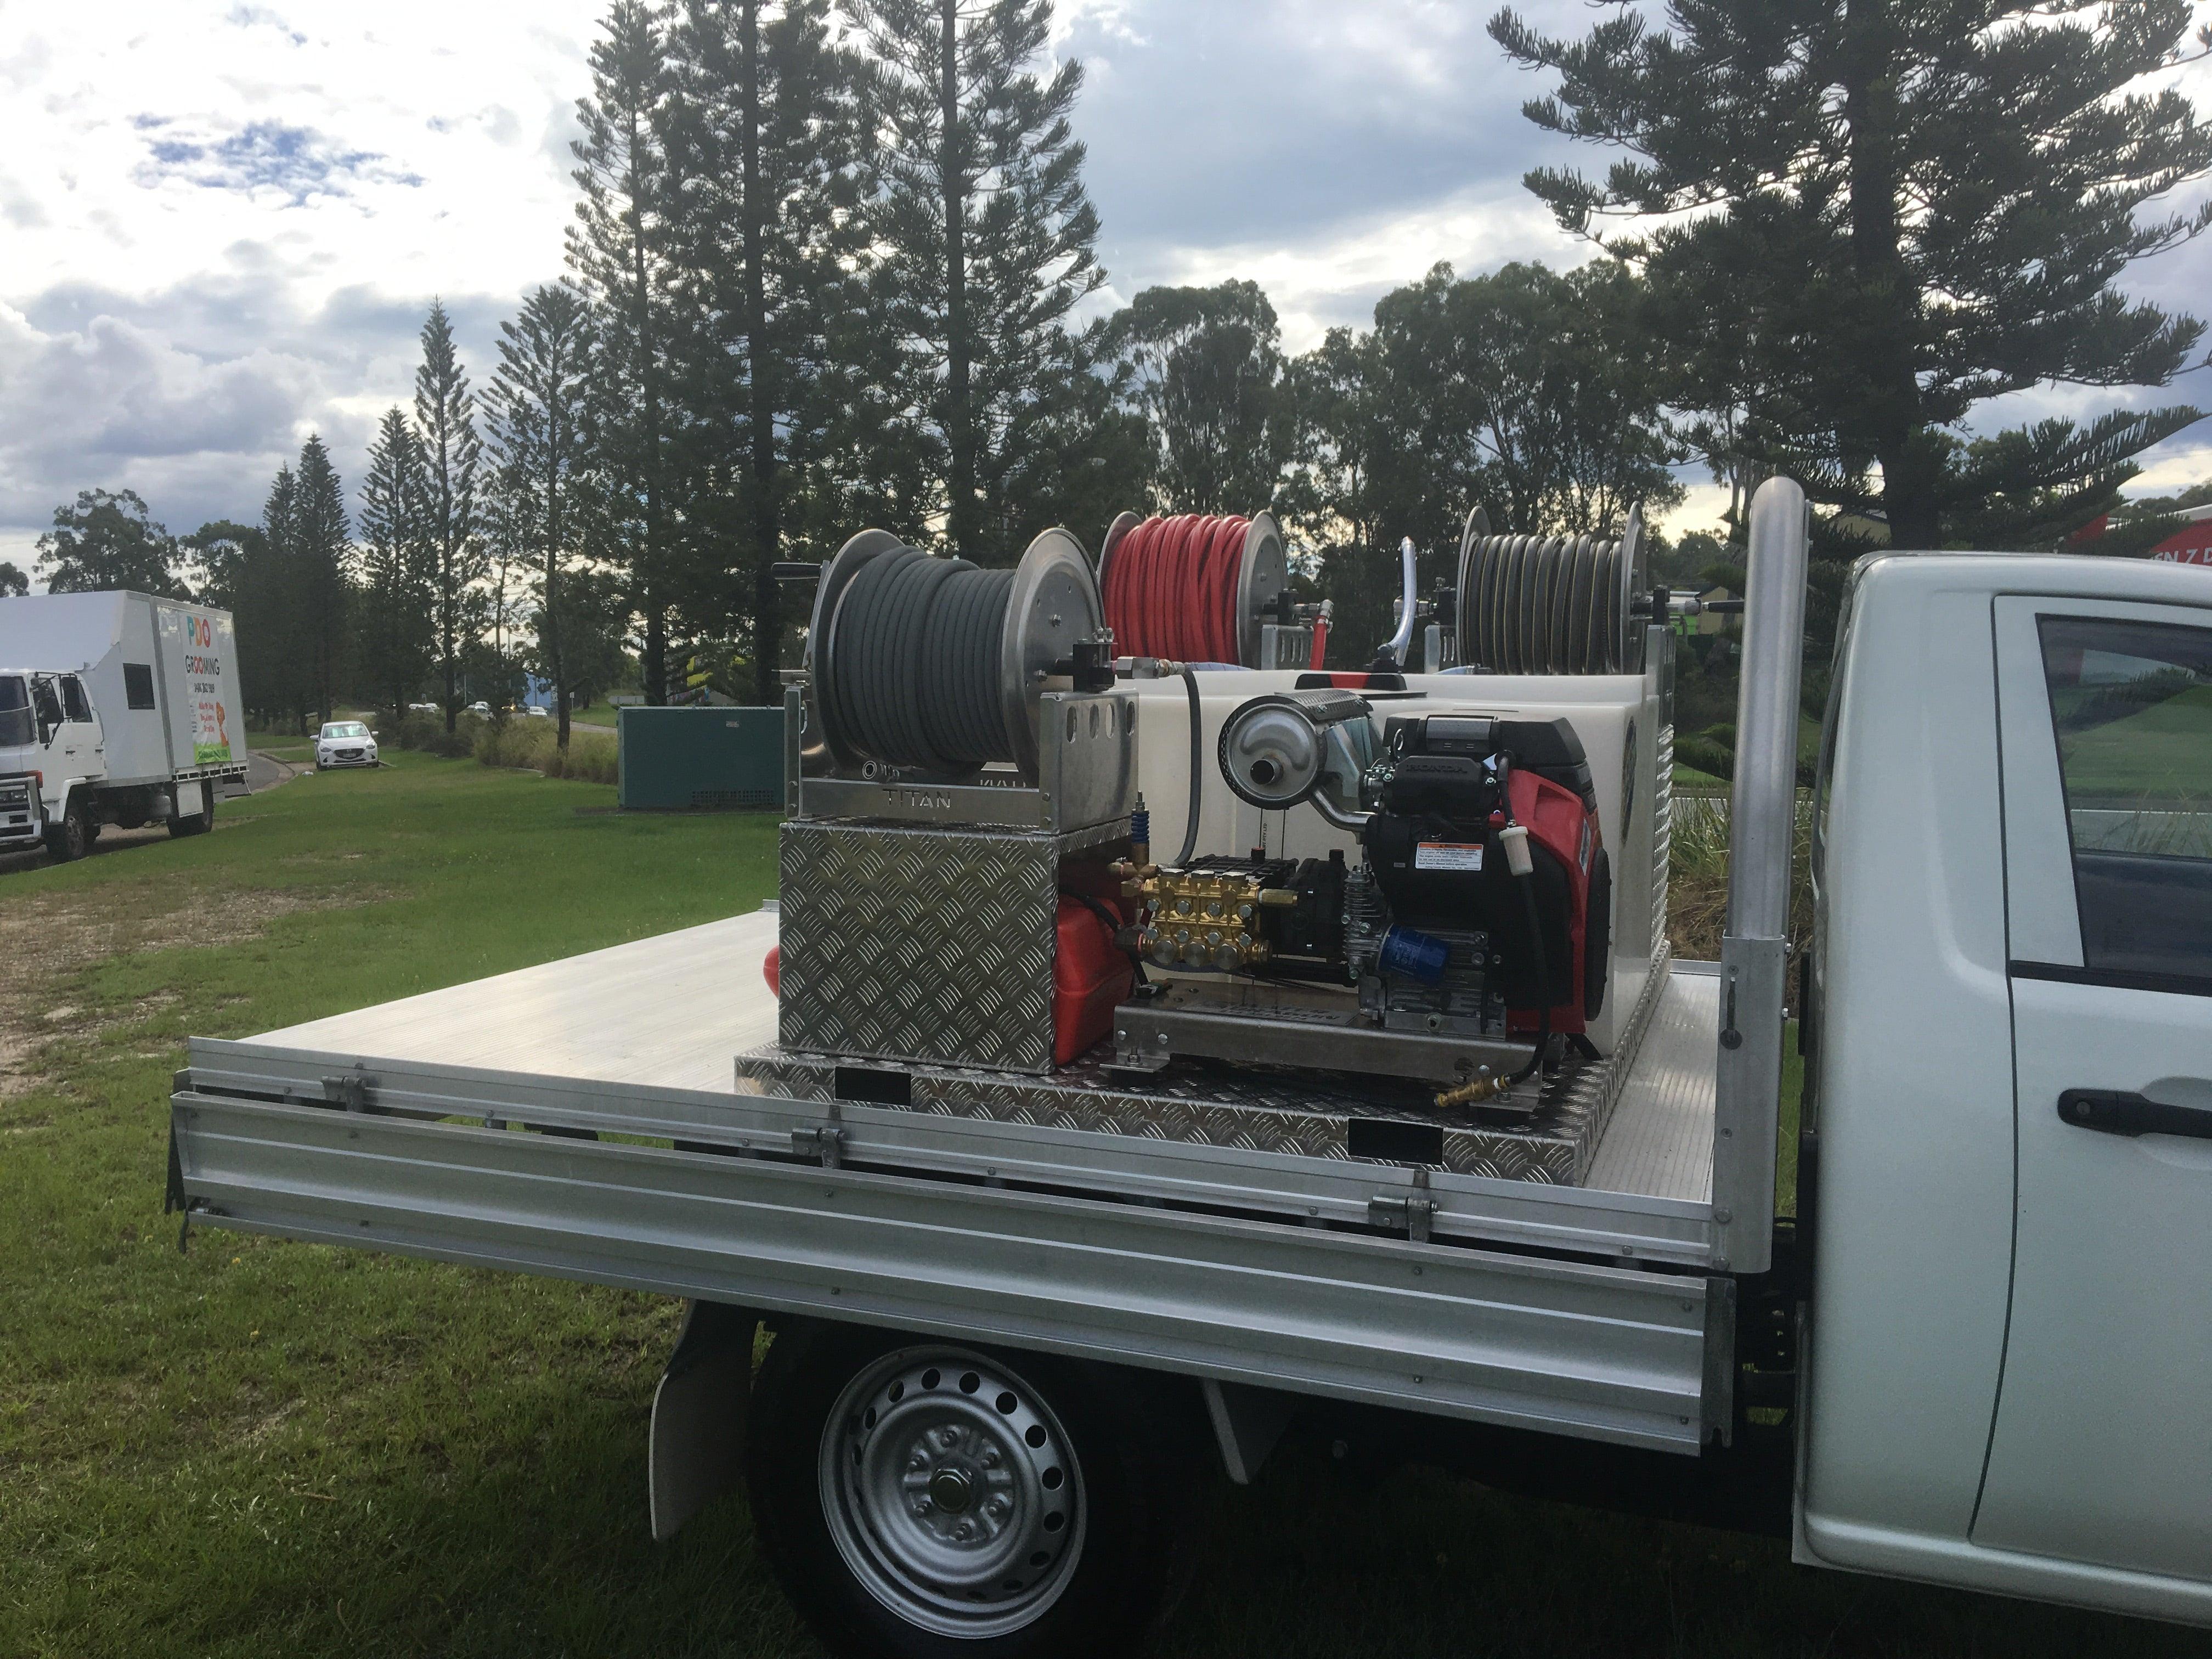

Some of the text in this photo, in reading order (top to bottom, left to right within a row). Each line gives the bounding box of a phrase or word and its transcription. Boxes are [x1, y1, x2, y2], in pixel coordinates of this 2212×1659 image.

[2151, 551, 2179, 562] EN
[2185, 549, 2198, 564] 7
[185, 655, 220, 676] GROOMING
[1406, 764, 1468, 774] HONDA
[882, 788, 951, 808] TITAN
